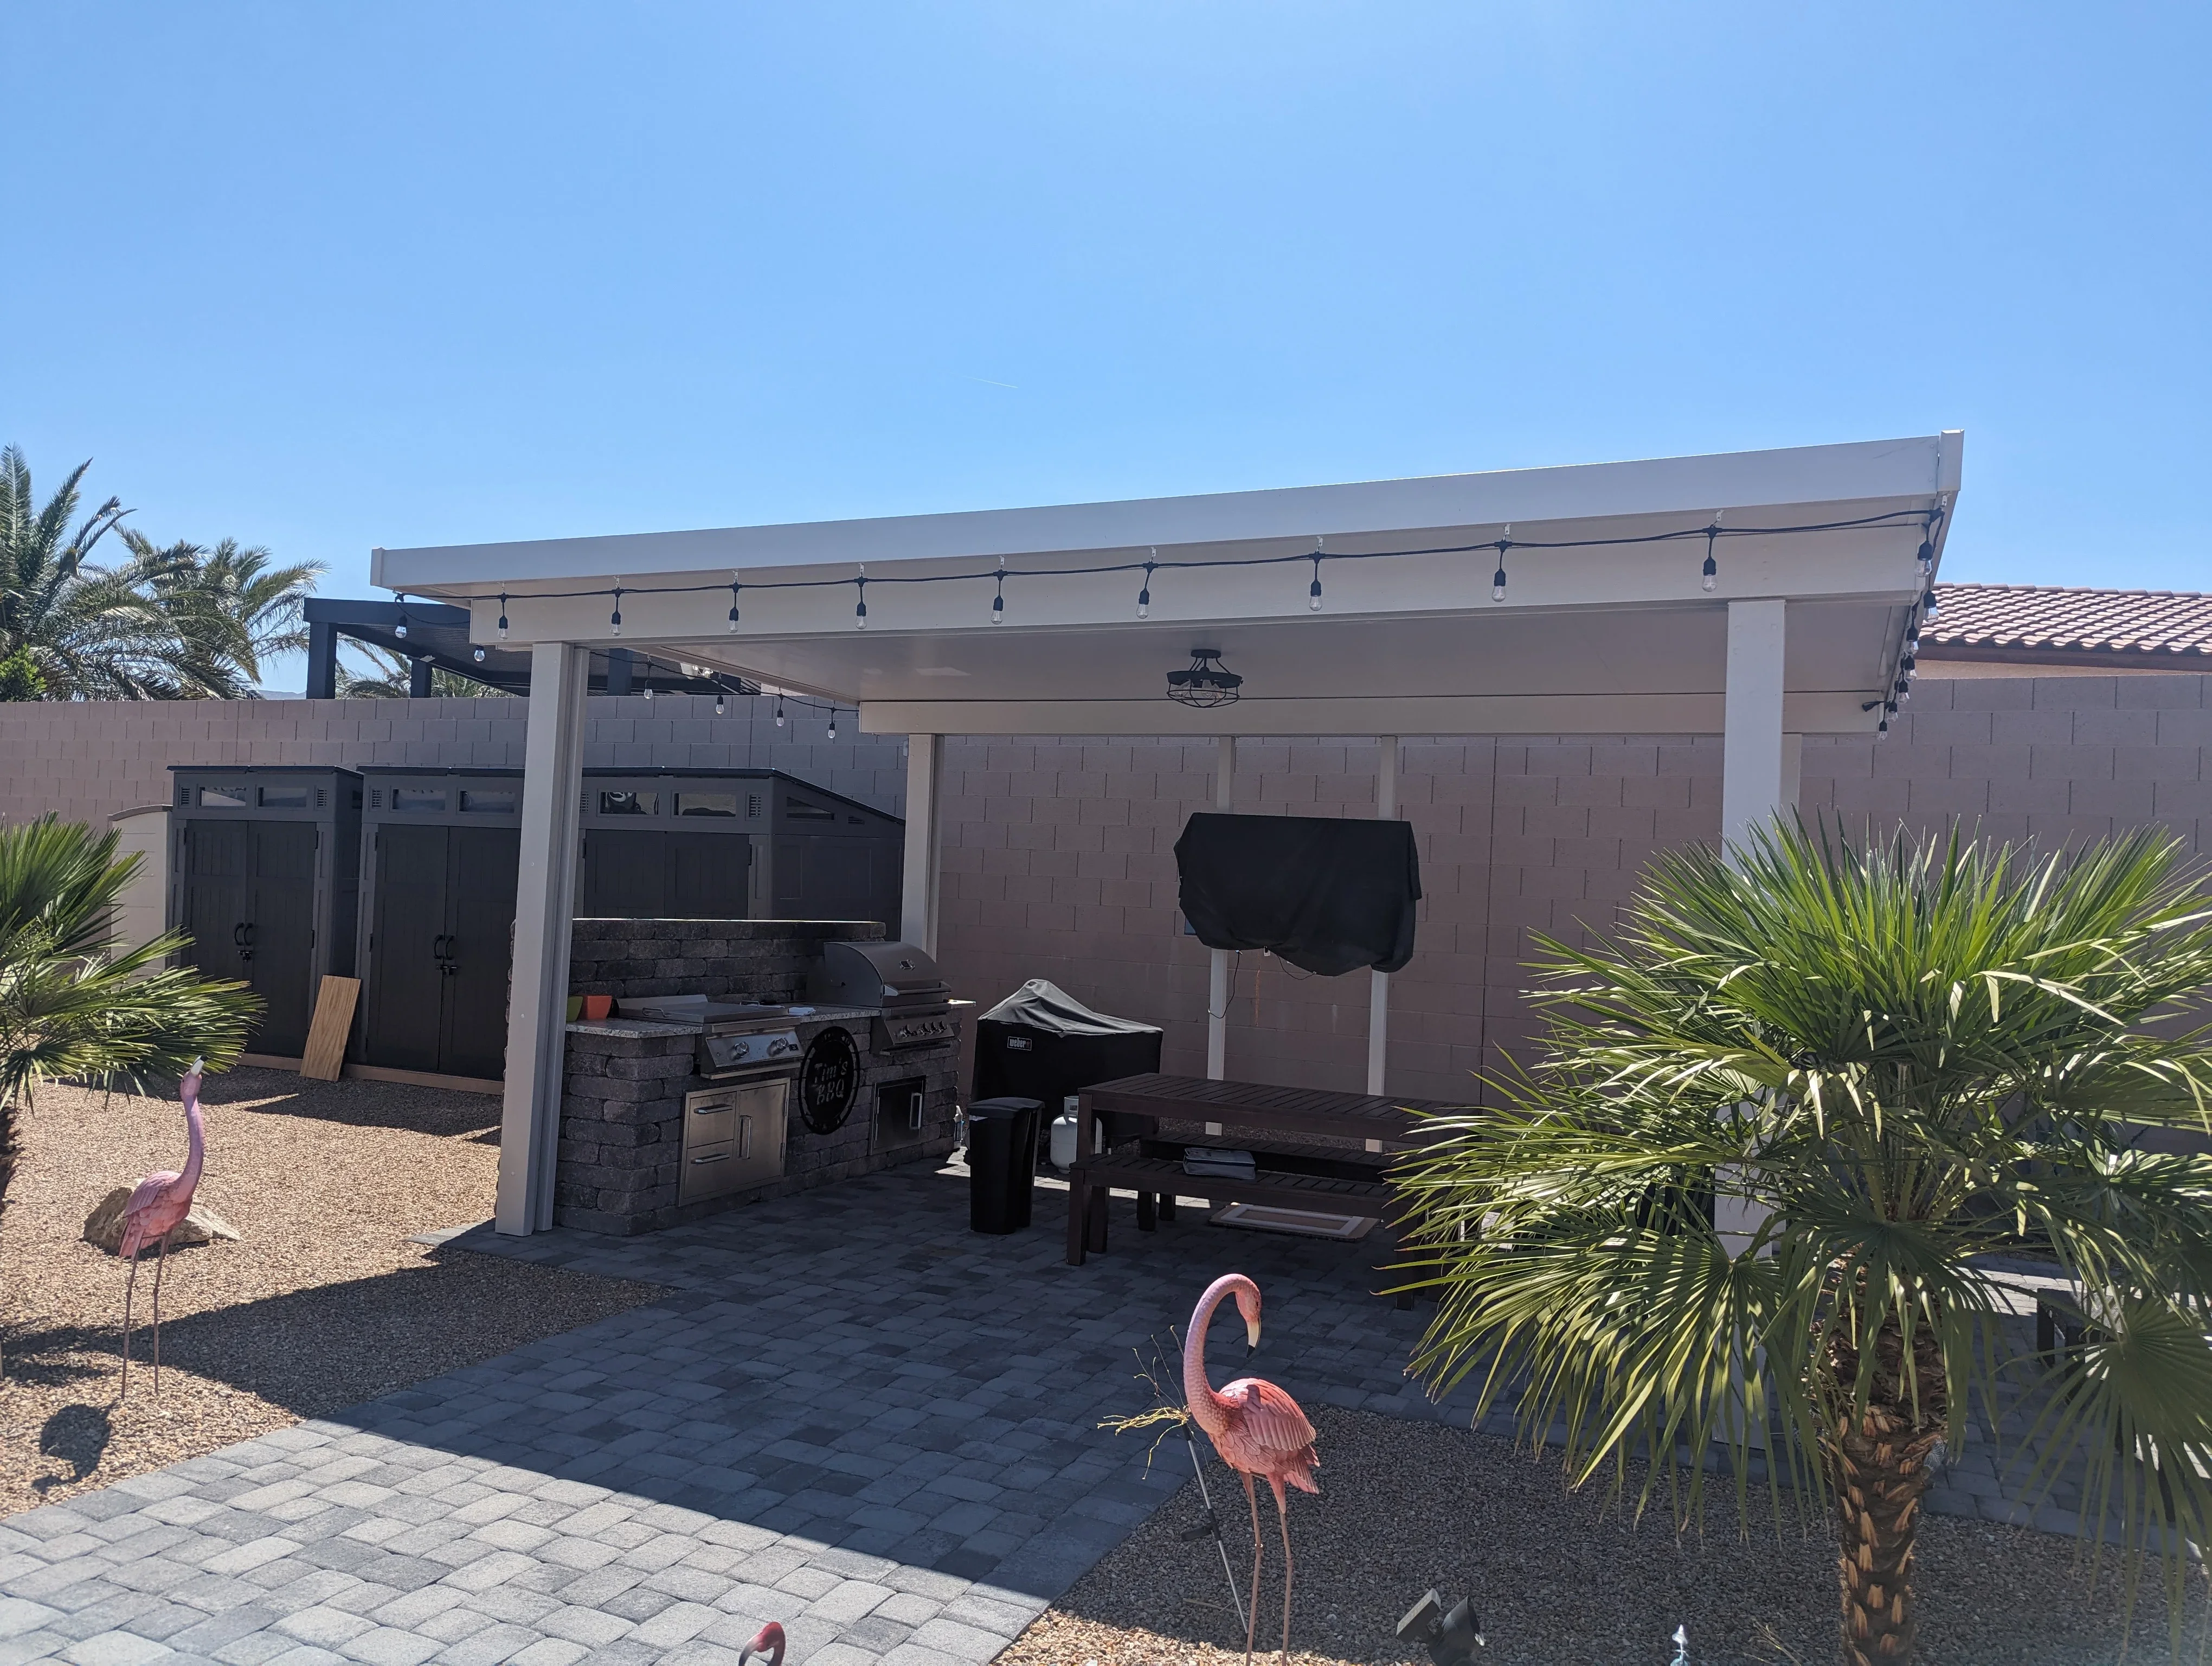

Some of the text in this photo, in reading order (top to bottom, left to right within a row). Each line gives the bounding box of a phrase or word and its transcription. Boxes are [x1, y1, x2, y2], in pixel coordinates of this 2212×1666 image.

[1009, 1037, 1026, 1048] weber
[815, 1057, 848, 1084] Tim's
[814, 1079, 844, 1105] BBQ
